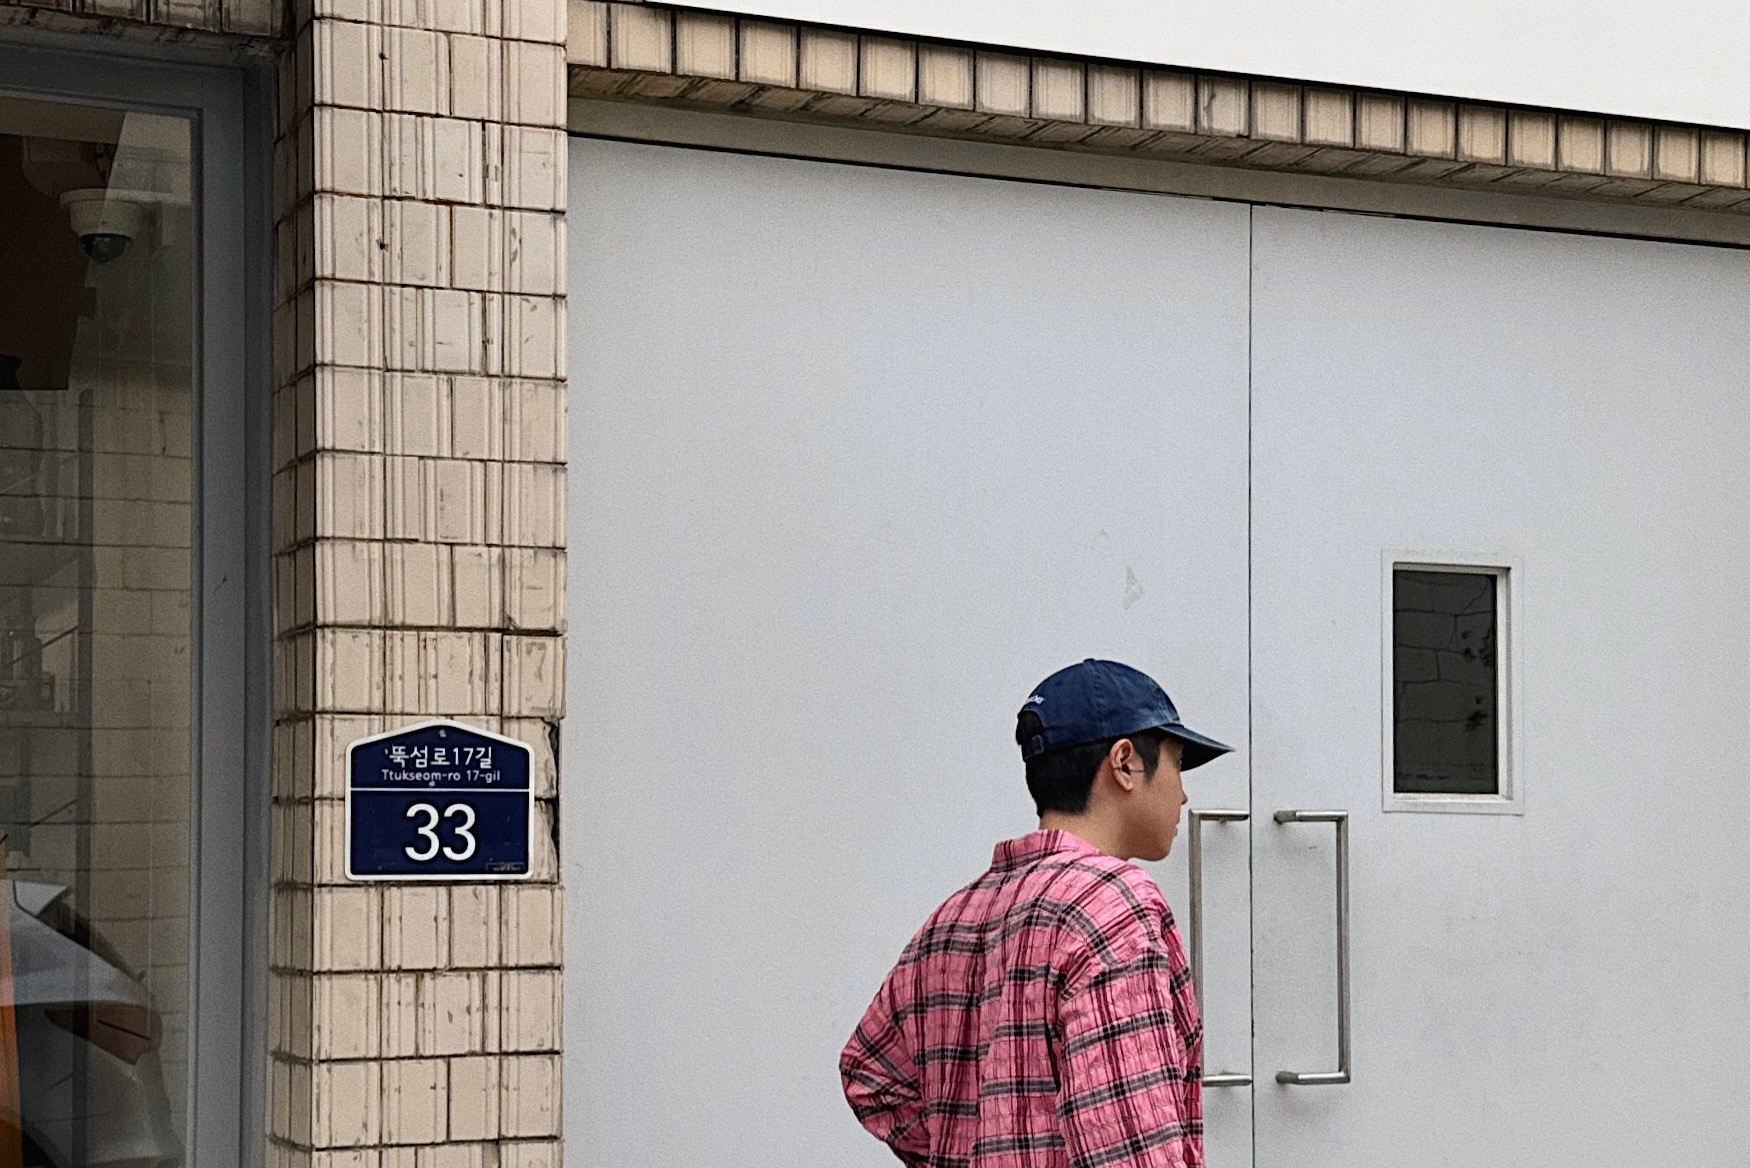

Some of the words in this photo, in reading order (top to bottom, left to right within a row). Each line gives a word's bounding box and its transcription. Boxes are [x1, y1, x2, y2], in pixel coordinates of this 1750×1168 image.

[389, 745, 492, 769] 뚝섬로17길
[381, 769, 461, 781] Ttukseom-ro
[466, 769, 501, 784] 17-gil
[405, 803, 476, 862] 33
